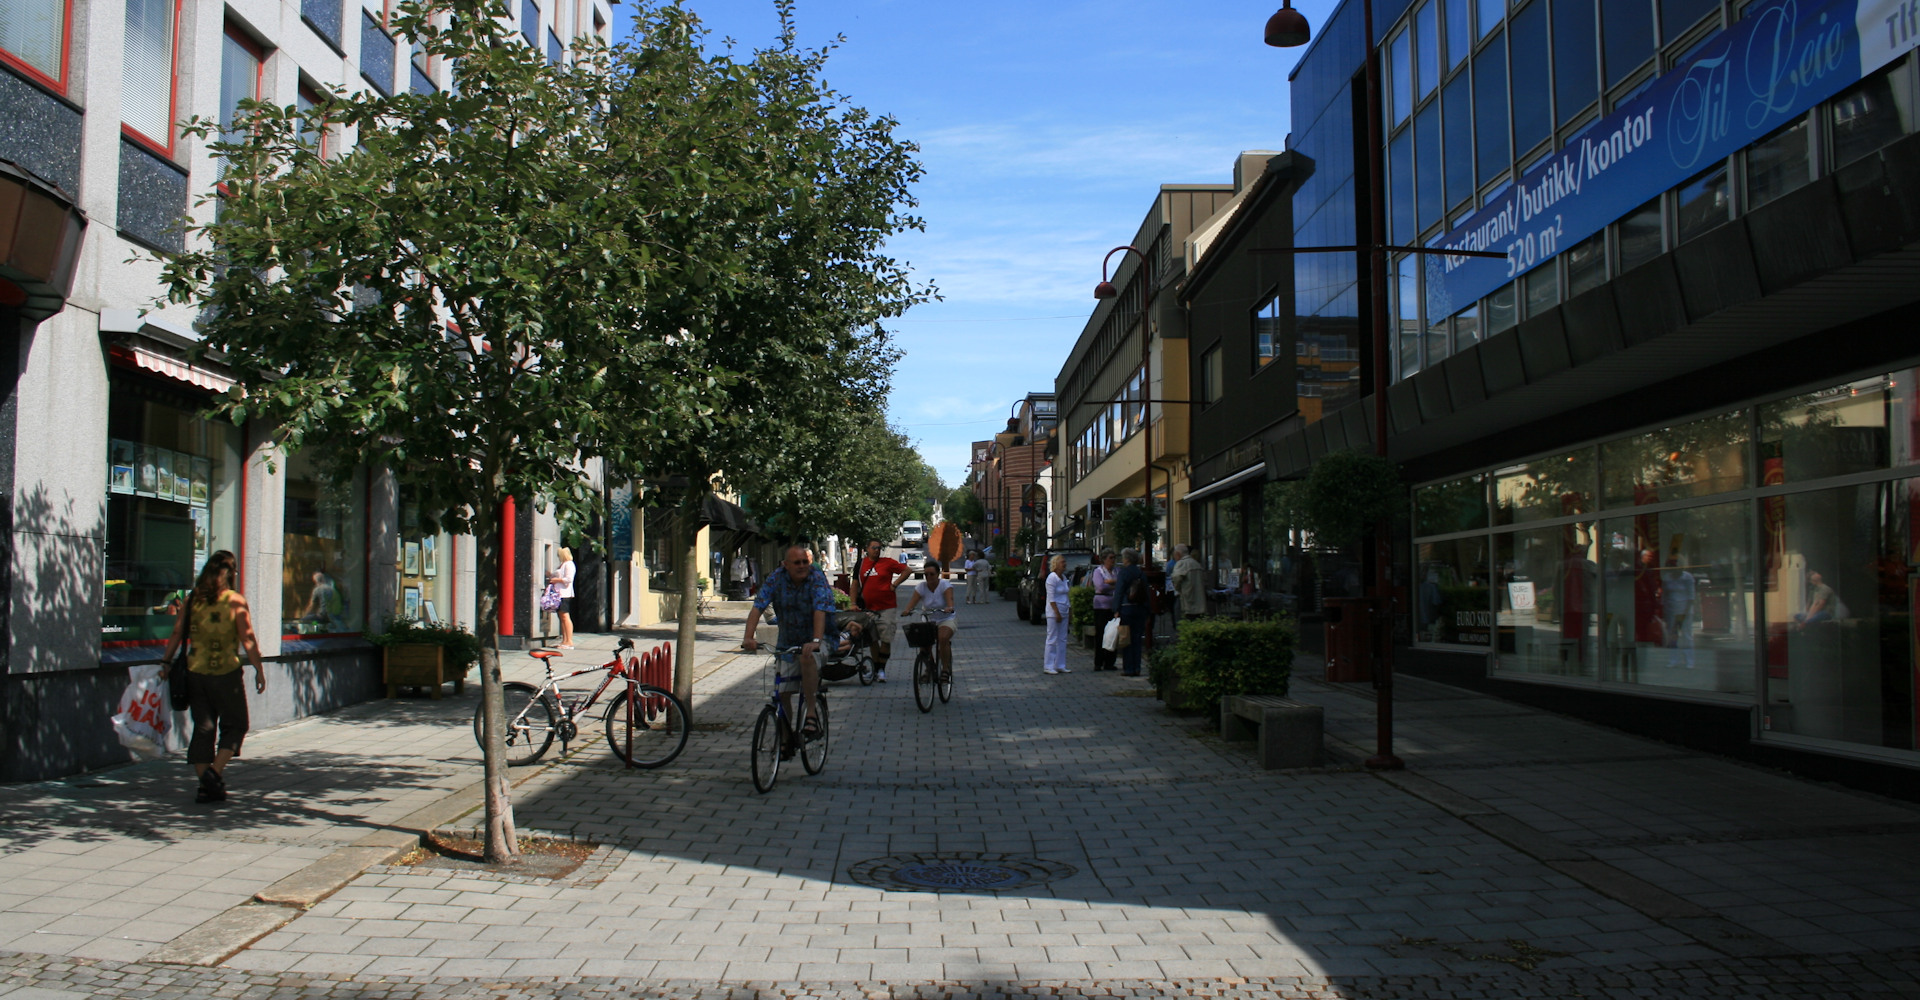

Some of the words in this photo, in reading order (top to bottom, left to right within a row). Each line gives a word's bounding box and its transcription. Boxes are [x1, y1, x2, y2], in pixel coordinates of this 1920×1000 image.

[1667, 40, 1732, 170] Til
[1745, 0, 1844, 130] Leie
[1444, 106, 1654, 274] Restaurant/butikk/kontor
[1507, 232, 1535, 278] 520
[1456, 610, 1476, 627] EURO
